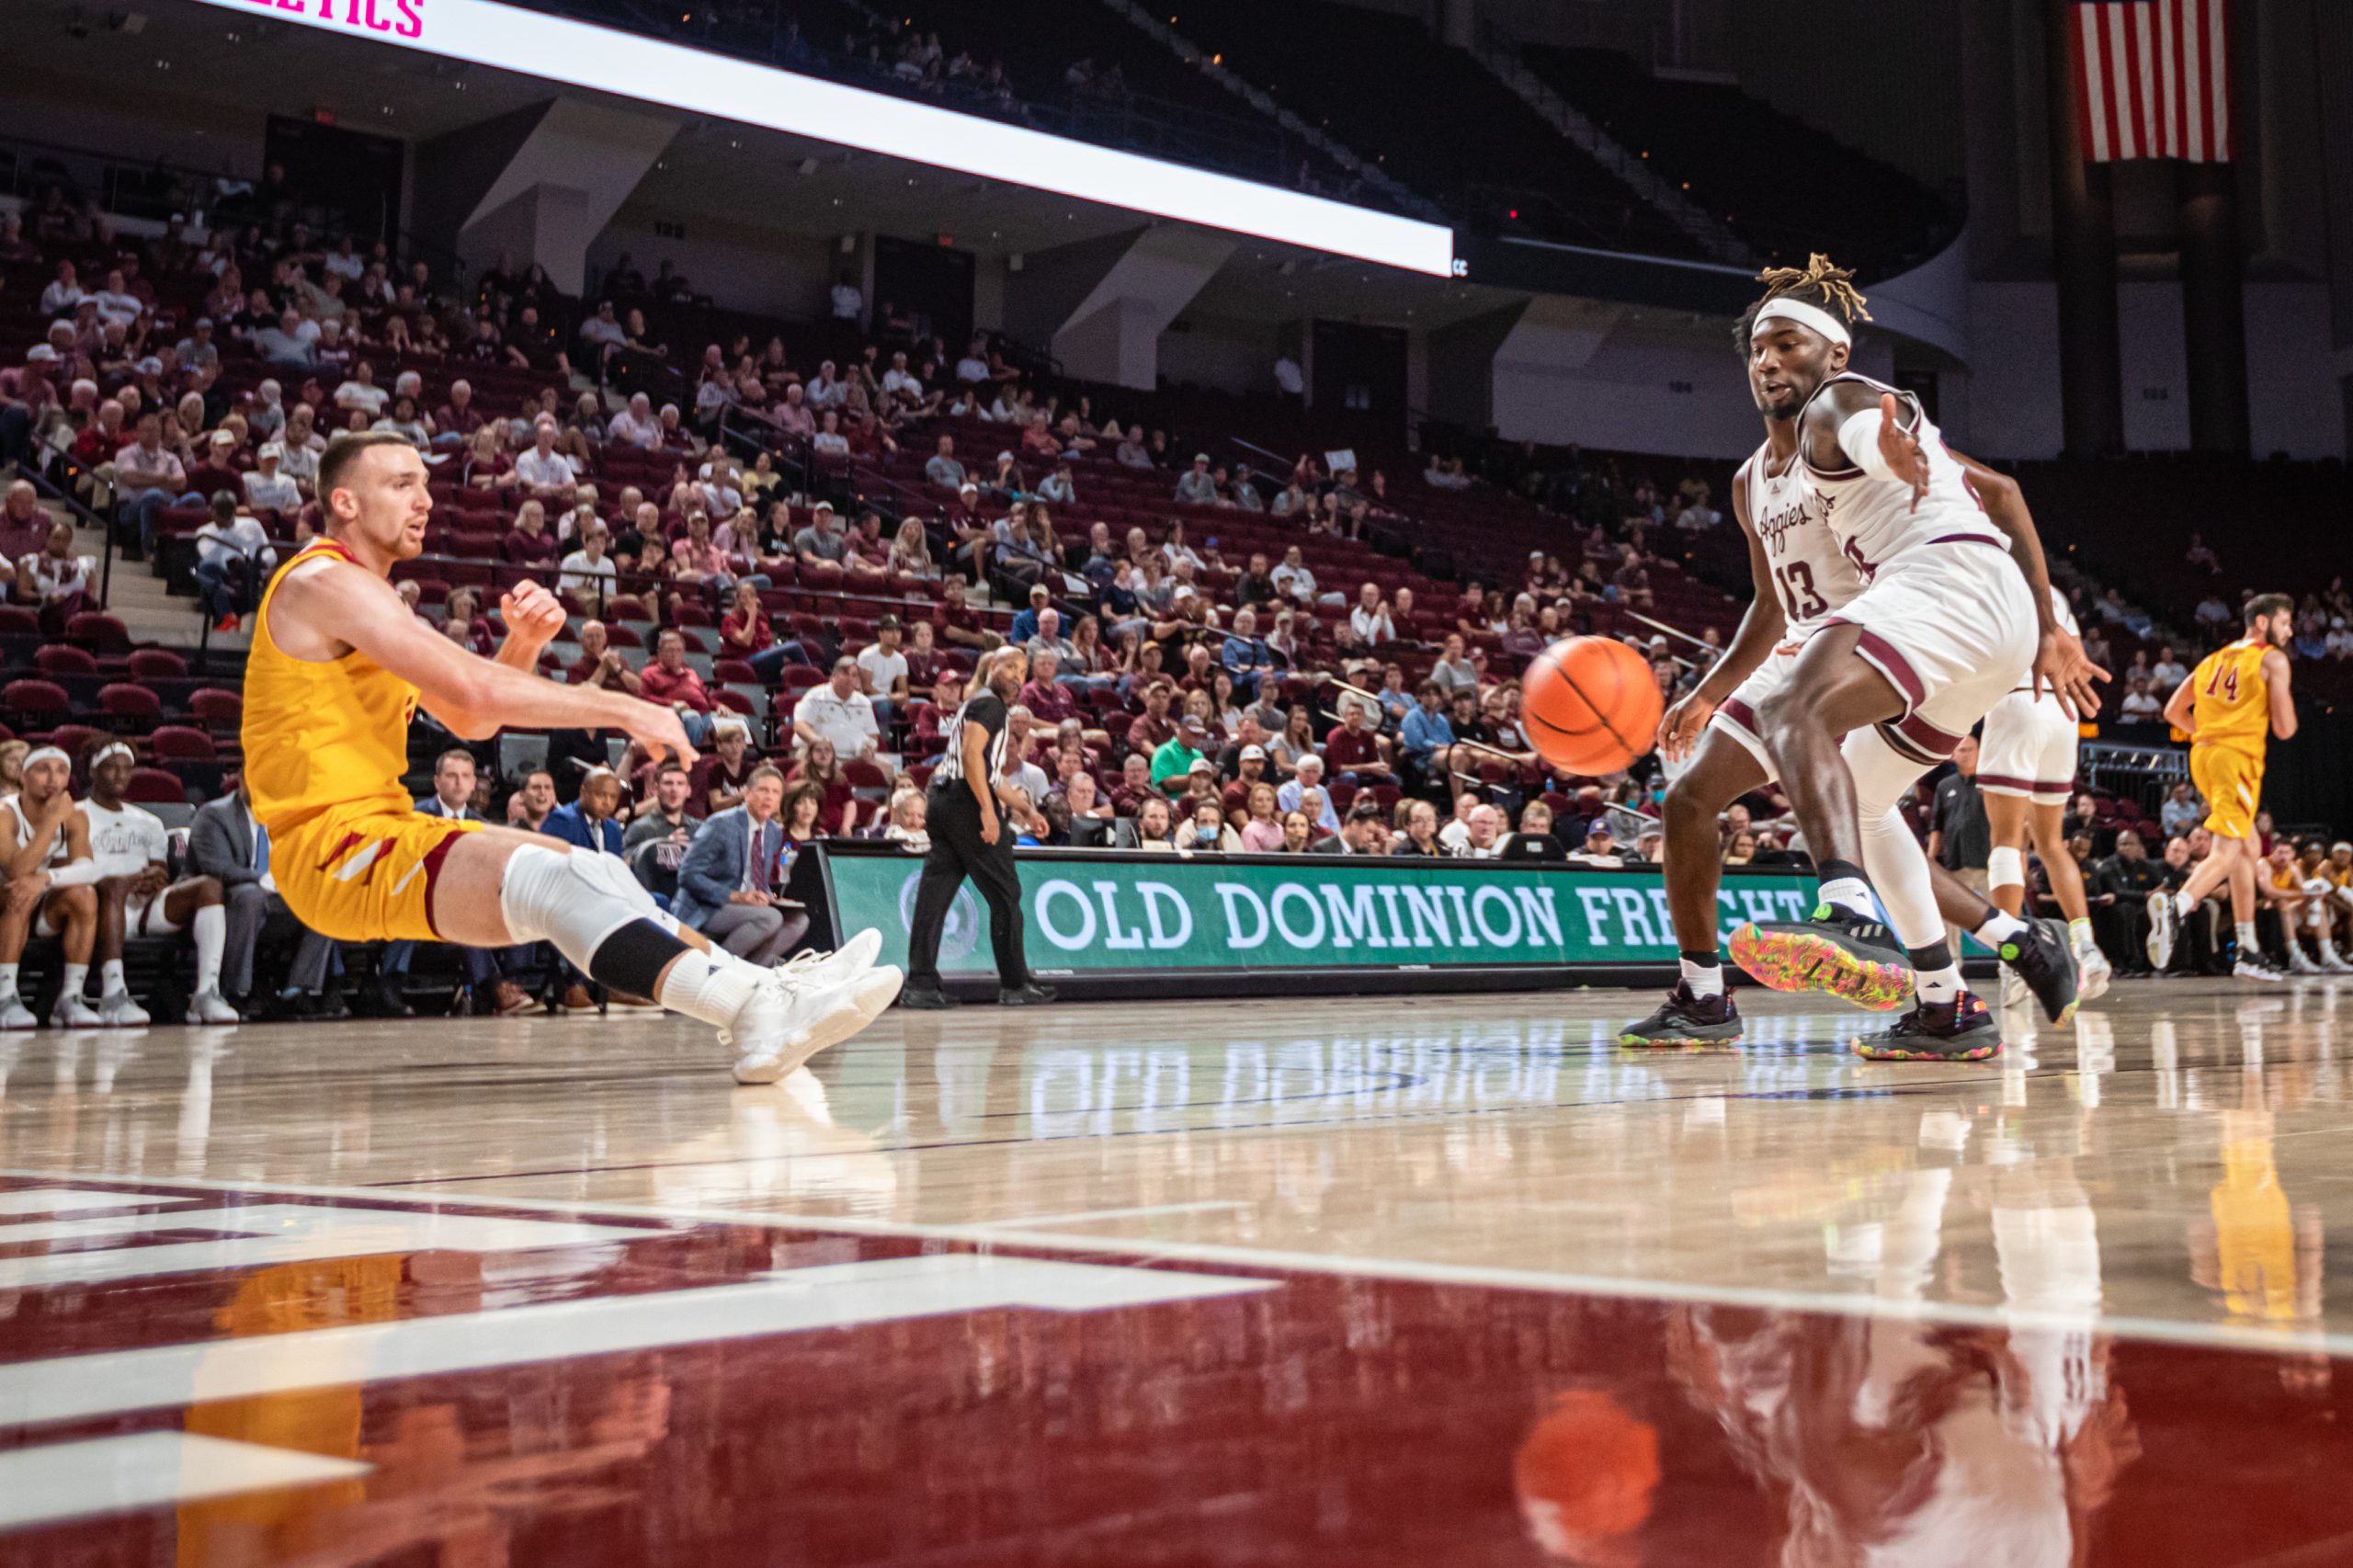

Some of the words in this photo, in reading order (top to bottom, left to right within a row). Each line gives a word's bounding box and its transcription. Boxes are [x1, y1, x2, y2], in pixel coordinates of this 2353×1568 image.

[1759, 502, 1813, 558] Aggies
[1775, 560, 1829, 623] 13
[2206, 663, 2238, 701] 14
[1035, 879, 1193, 951] OLD
[1214, 881, 1564, 949] DOMINION
[1575, 887, 1807, 947] FREGHT
